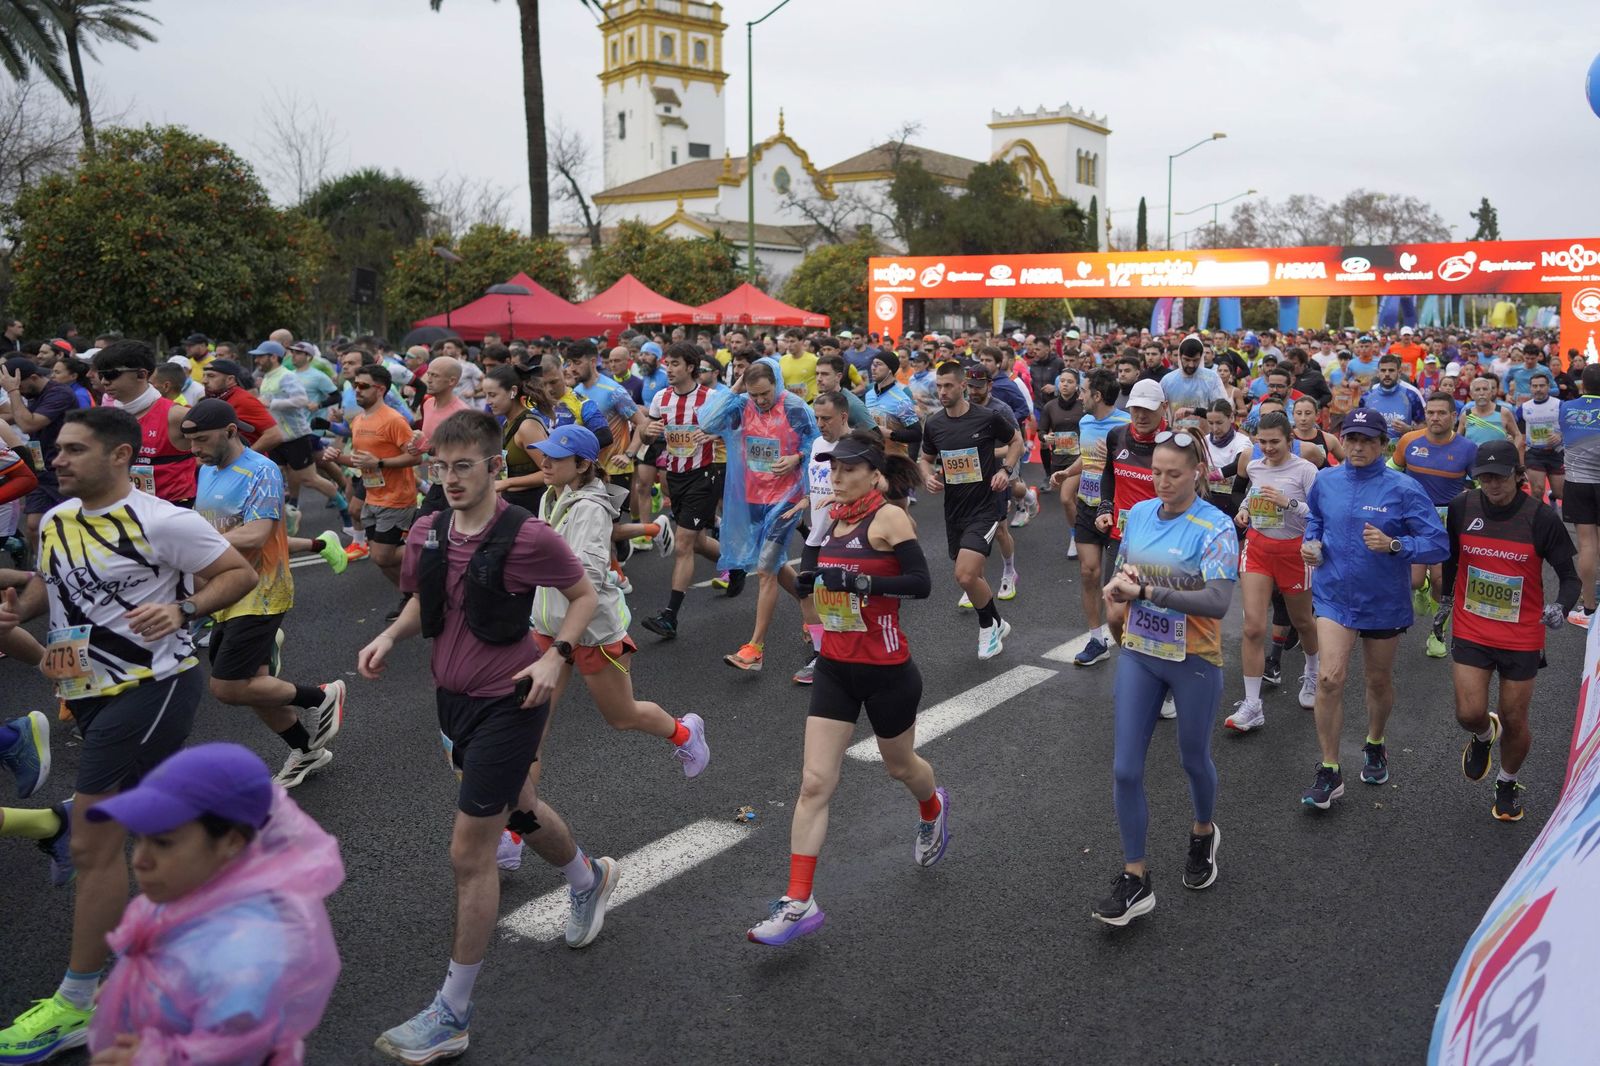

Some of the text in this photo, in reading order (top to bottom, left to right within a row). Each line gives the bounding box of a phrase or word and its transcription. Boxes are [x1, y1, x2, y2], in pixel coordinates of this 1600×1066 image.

[669, 432, 691, 443] 6015
[750, 444, 772, 457] 4916
[947, 458, 970, 470] 5951
[1114, 467, 1153, 482] PUROSANG
[1081, 479, 1100, 493] 2986
[1463, 544, 1529, 562] PUROSANGUE
[65, 566, 149, 606] Sergio
[1471, 579, 1513, 602] 13089
[1135, 609, 1169, 634] 2559
[45, 646, 75, 670] 4773
